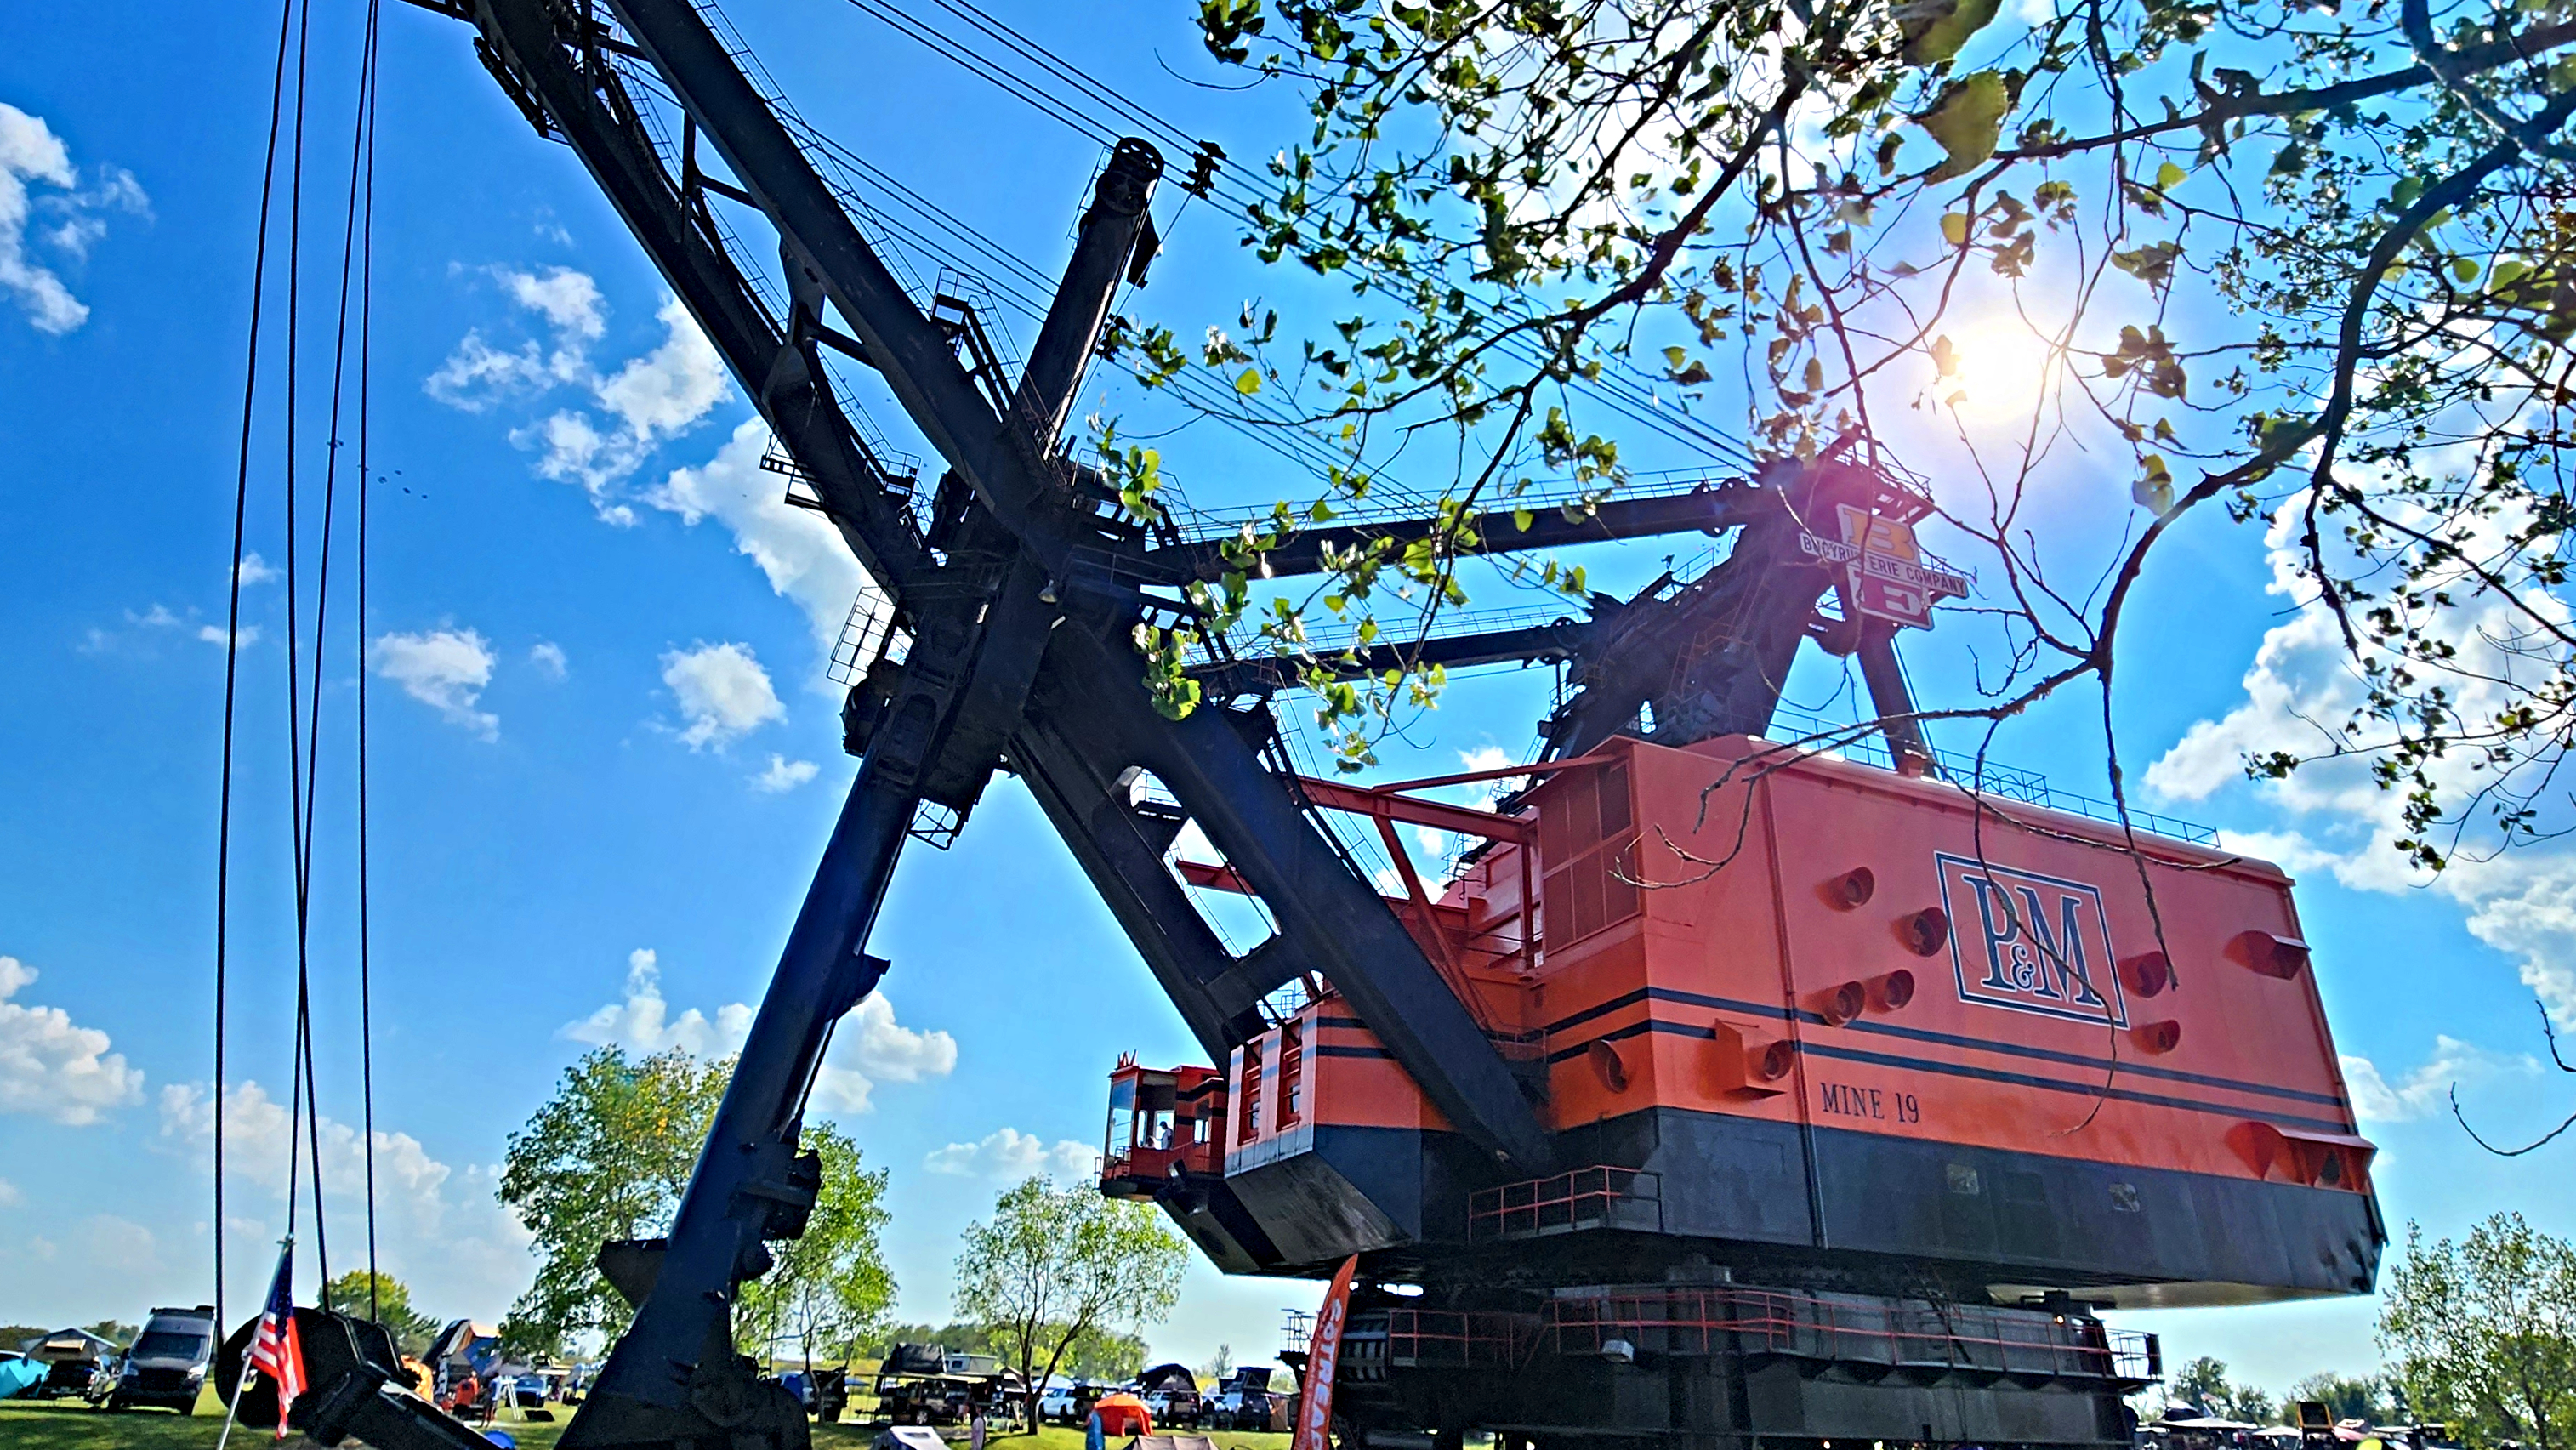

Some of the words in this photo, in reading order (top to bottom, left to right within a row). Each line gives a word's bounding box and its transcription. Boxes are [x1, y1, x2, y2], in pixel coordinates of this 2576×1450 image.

[1906, 566, 1966, 594] COMPANY
[1961, 873, 2105, 1008] P&M
[1820, 1083, 1885, 1119] MINE
[1896, 1092, 1919, 1123] 19
